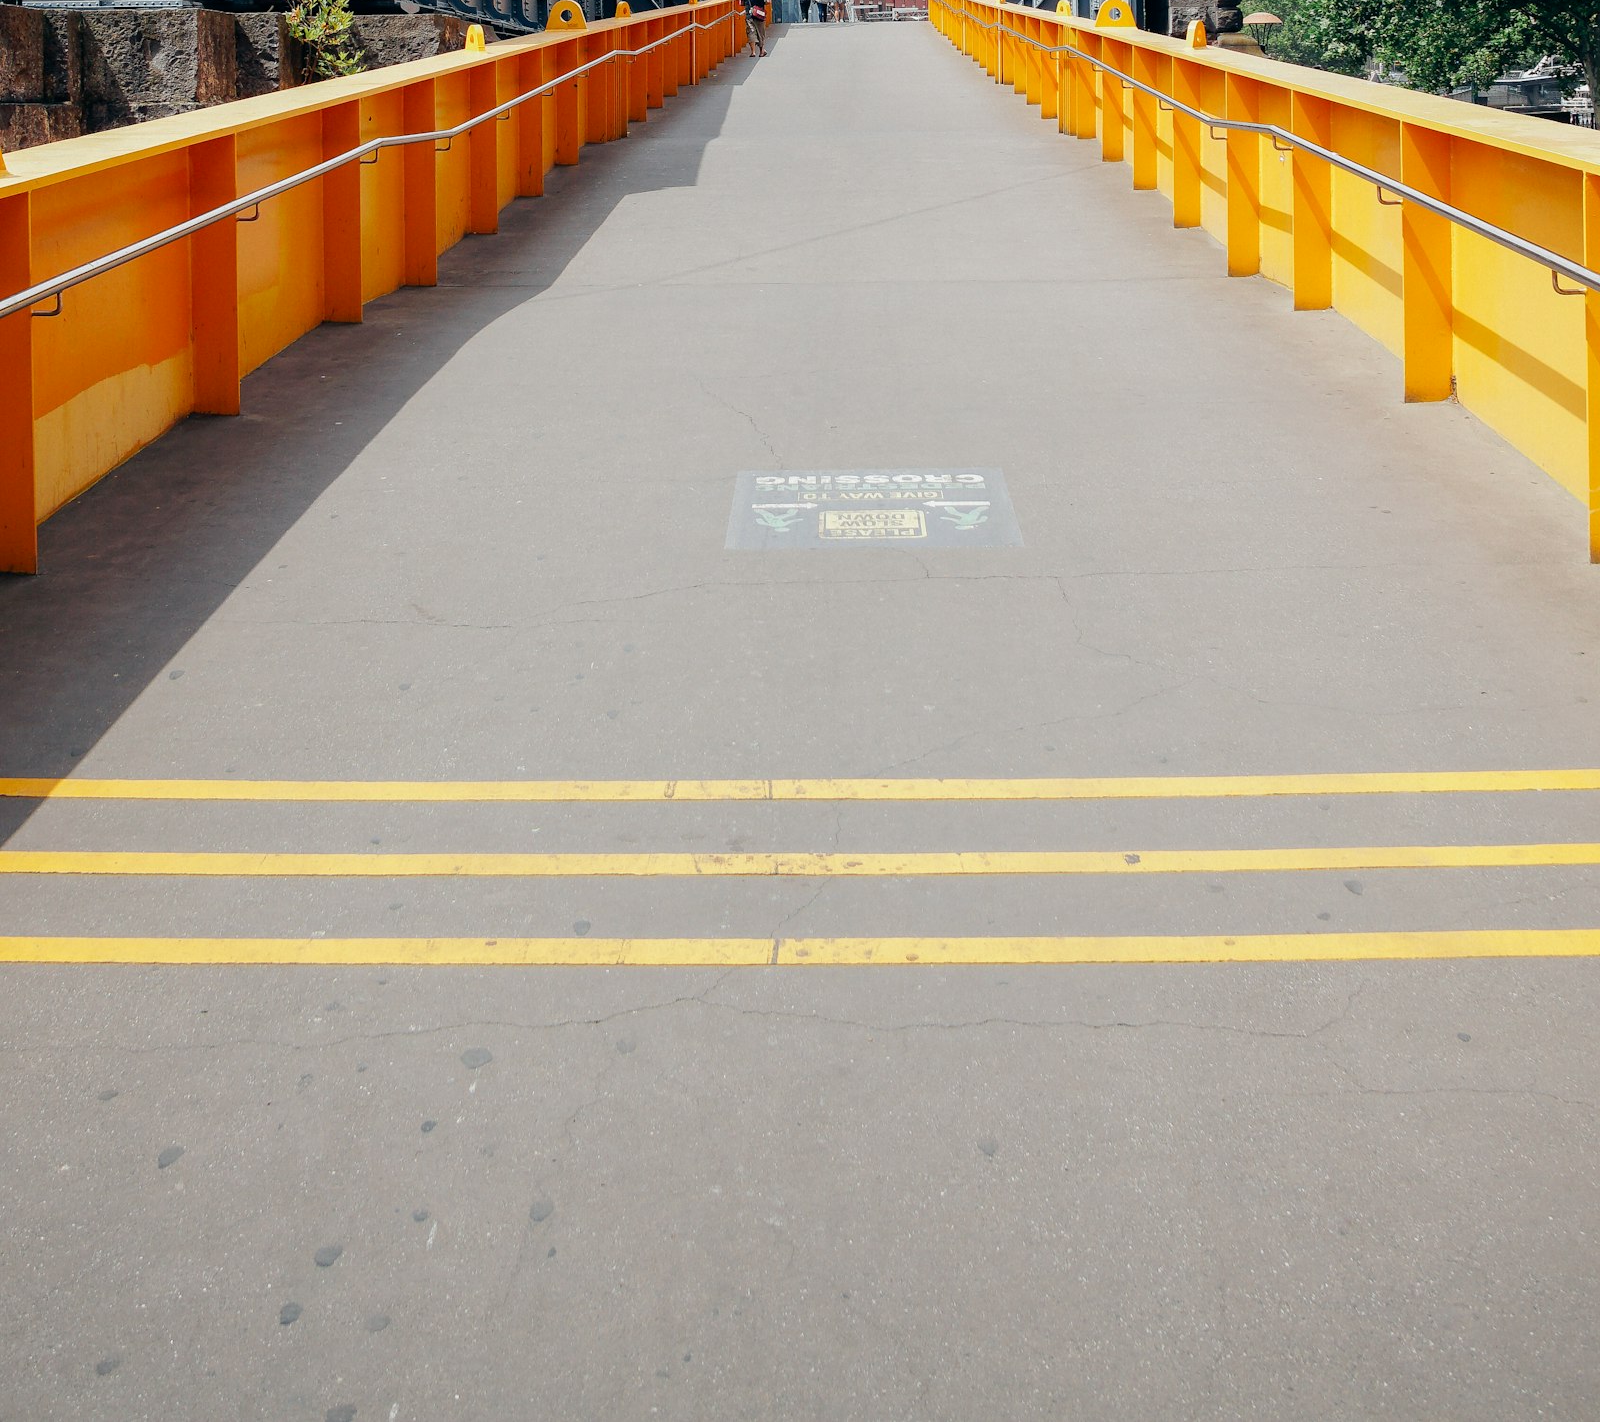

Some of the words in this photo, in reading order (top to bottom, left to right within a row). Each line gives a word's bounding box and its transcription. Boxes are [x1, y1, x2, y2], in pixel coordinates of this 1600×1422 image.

[755, 474, 985, 484] CROSSING
[755, 482, 986, 491] PEDESTRIANS
[839, 492, 884, 500] WAY
[889, 491, 938, 499] GIVE
[830, 528, 915, 536] PLEASE
